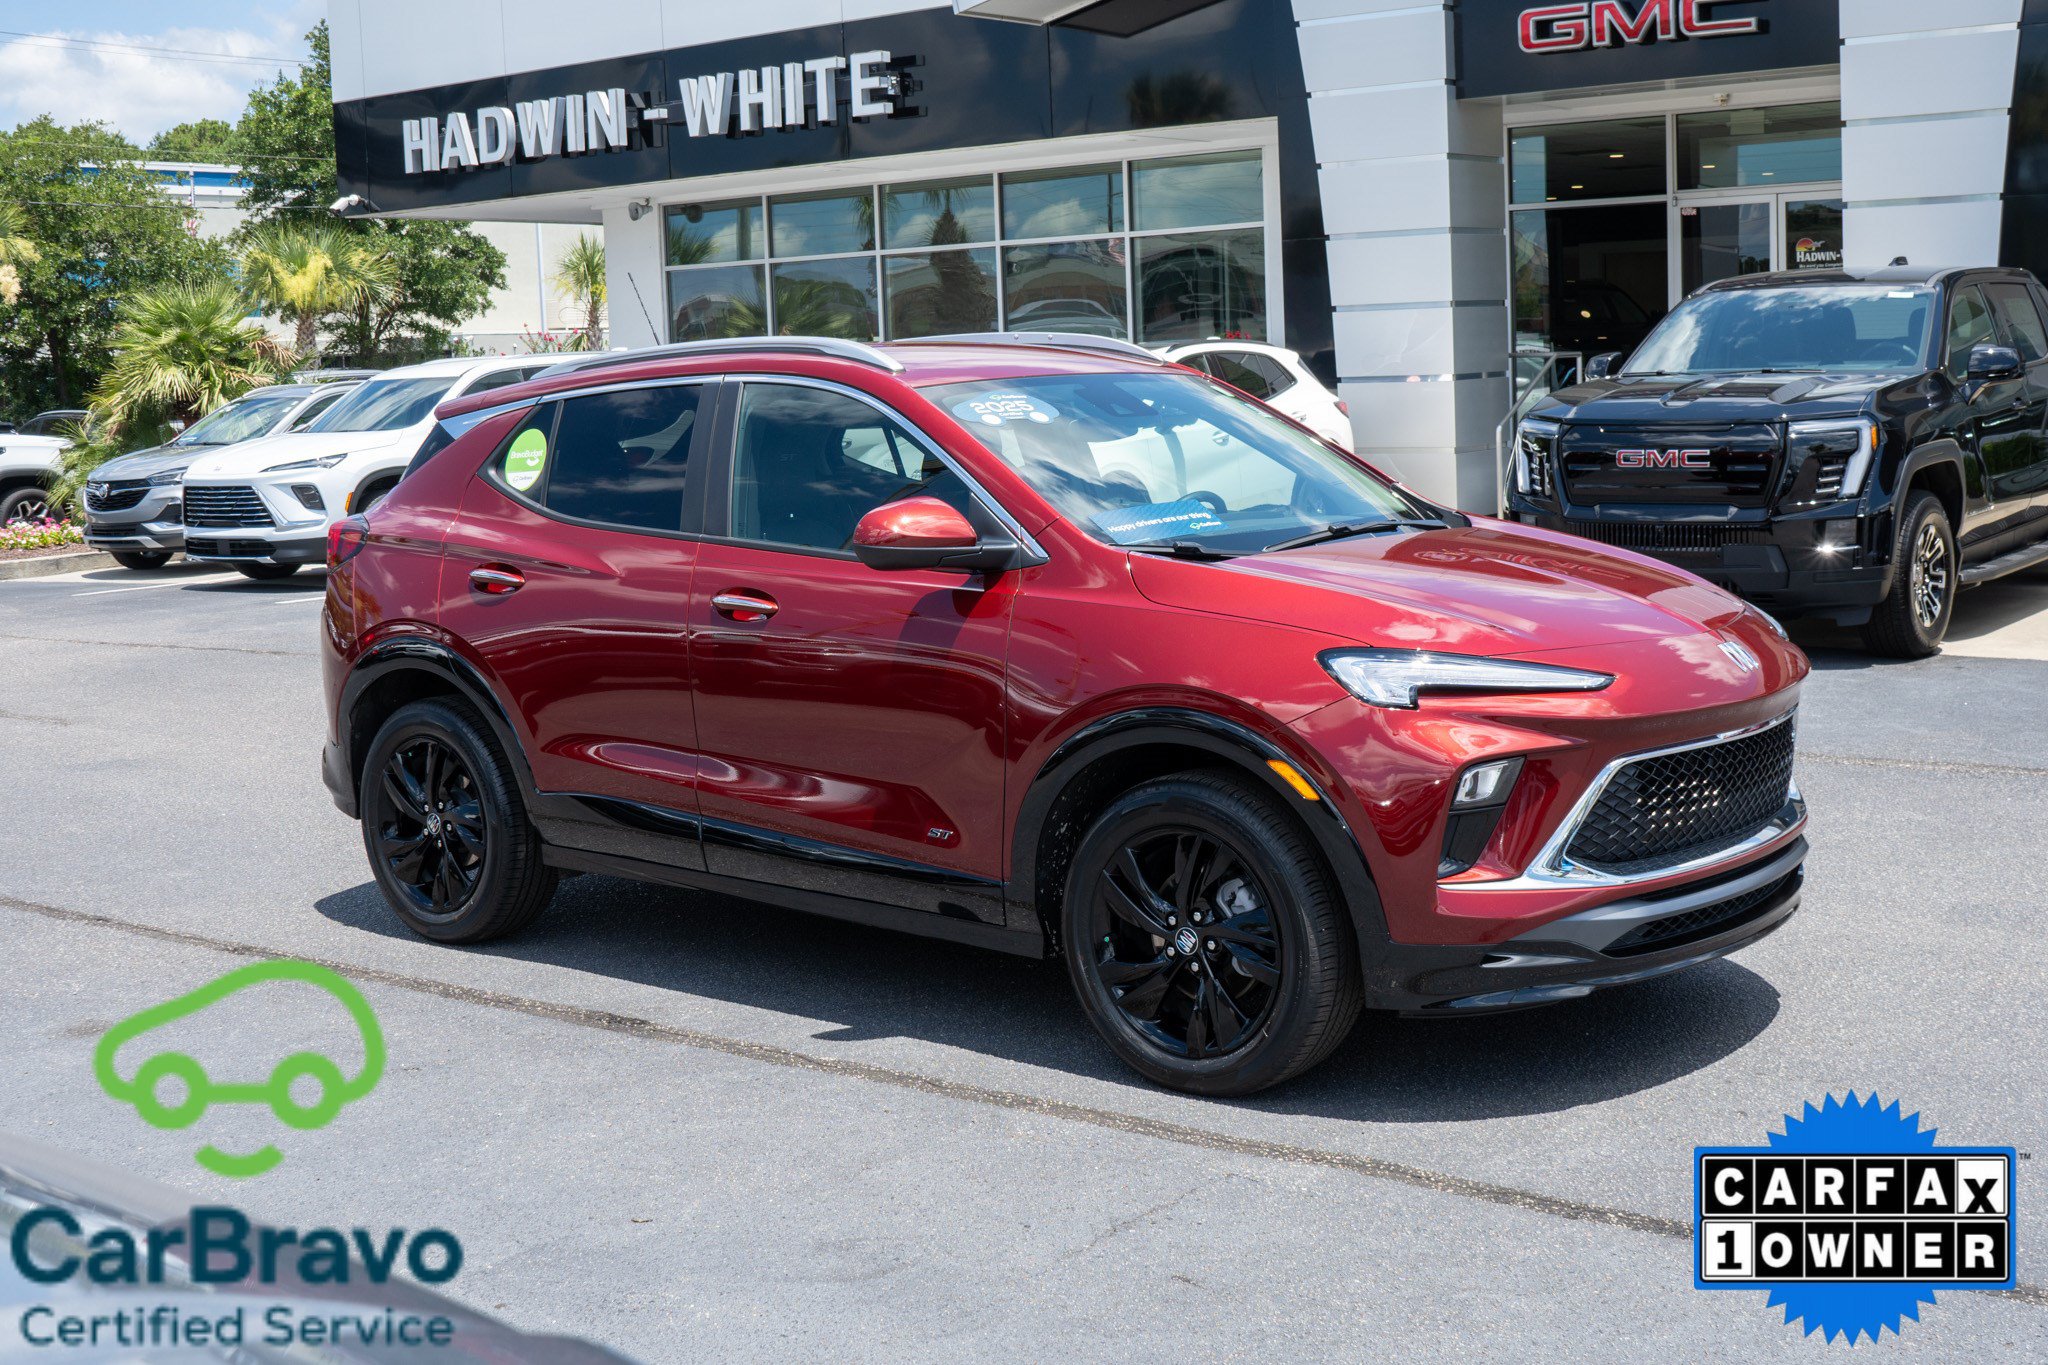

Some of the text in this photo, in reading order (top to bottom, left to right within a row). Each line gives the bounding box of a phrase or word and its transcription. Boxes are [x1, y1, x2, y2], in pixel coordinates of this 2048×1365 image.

[1518, 0, 1758, 53] GMC
[970, 400, 1034, 414] 2025
[1616, 449, 1711, 468] GMC
[1107, 523, 1136, 532] Happy
[1135, 518, 1164, 528] drivers
[927, 827, 954, 840] ST
